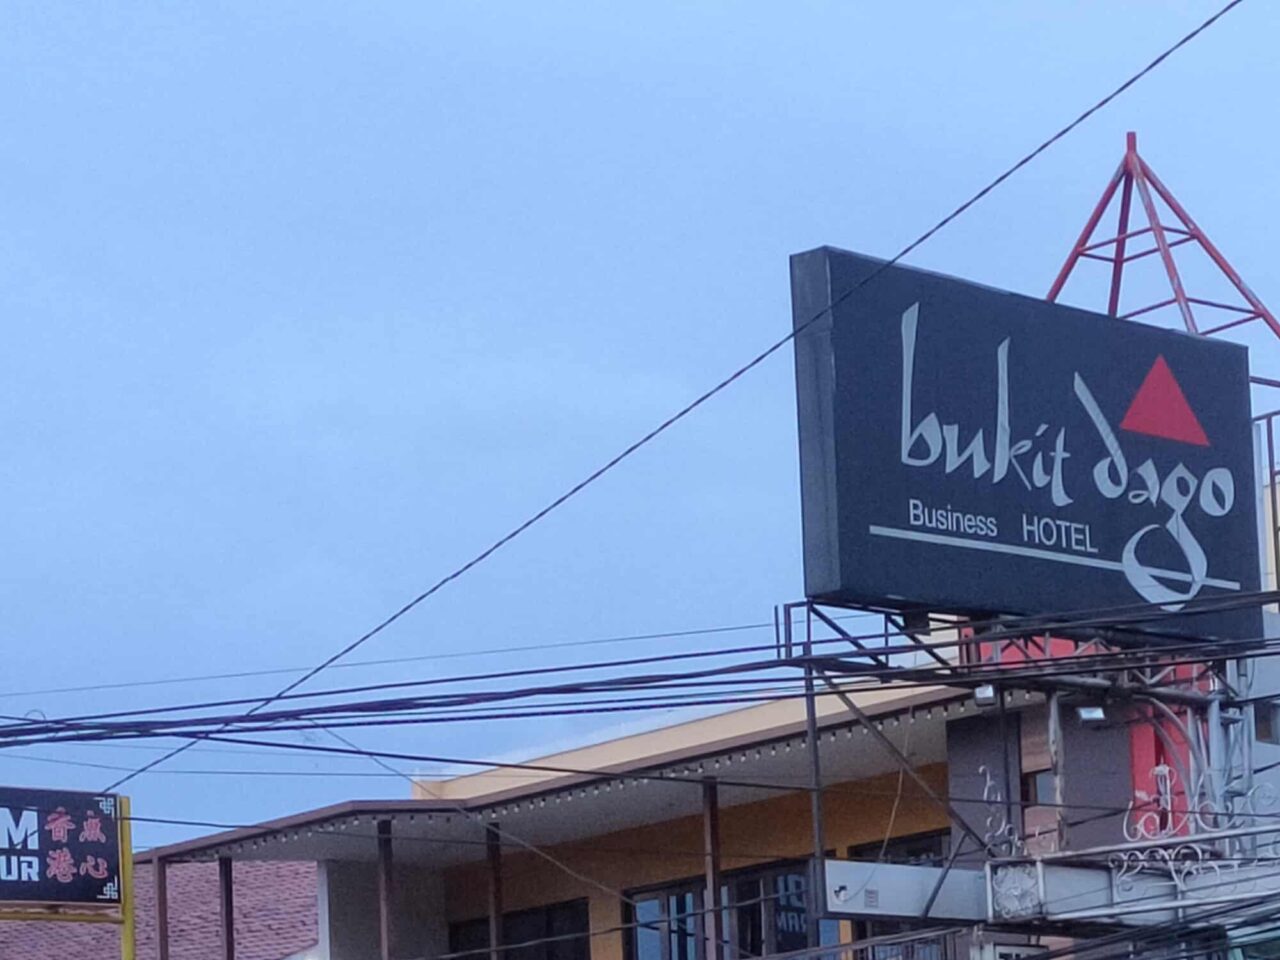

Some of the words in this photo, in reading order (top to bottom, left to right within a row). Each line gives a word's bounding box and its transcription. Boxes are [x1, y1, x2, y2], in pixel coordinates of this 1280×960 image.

[900, 301, 1074, 507] bukit
[1073, 371, 1236, 612] dago
[909, 498, 998, 537] Business
[1022, 513, 1099, 553] HOTEL
